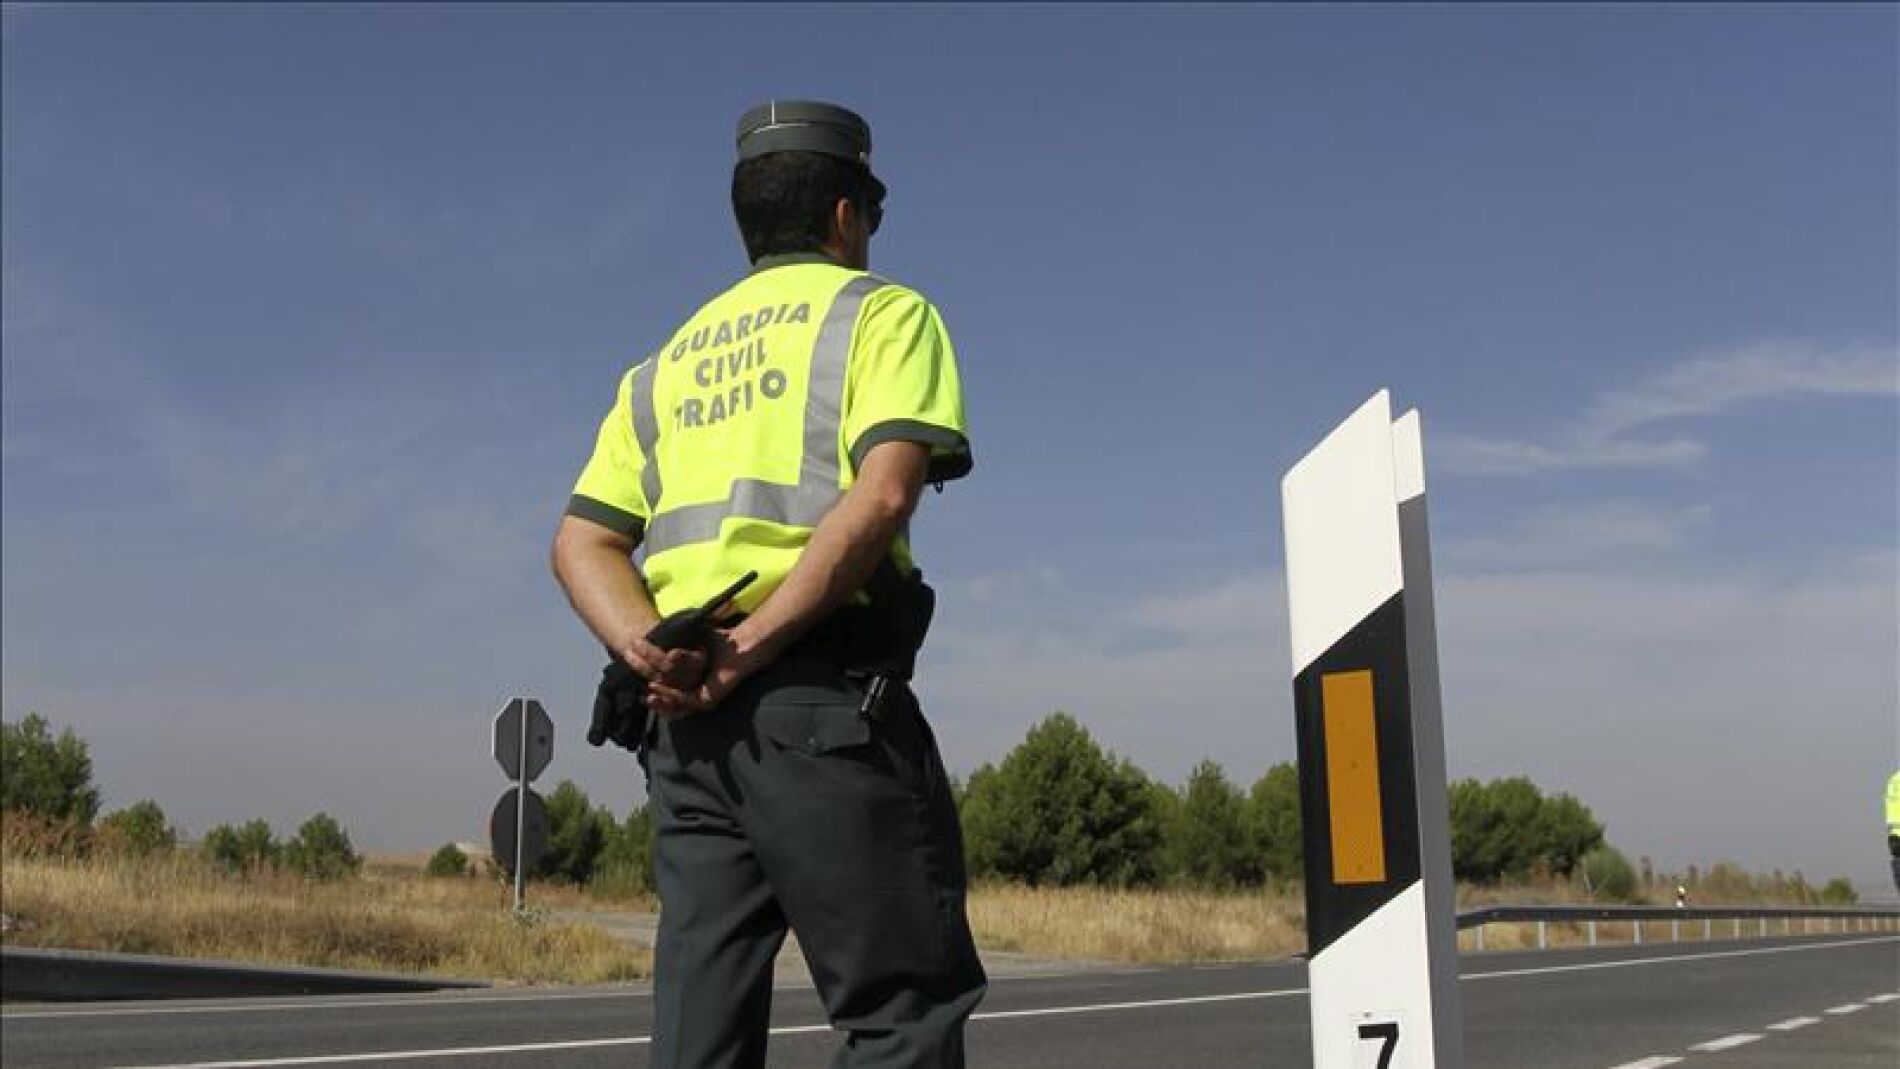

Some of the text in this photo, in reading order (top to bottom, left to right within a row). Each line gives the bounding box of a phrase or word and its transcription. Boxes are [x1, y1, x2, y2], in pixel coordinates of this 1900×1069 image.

[671, 303, 810, 361] GUARDIA
[695, 337, 766, 387] CIVIL
[1358, 1022, 1399, 1069] 7
